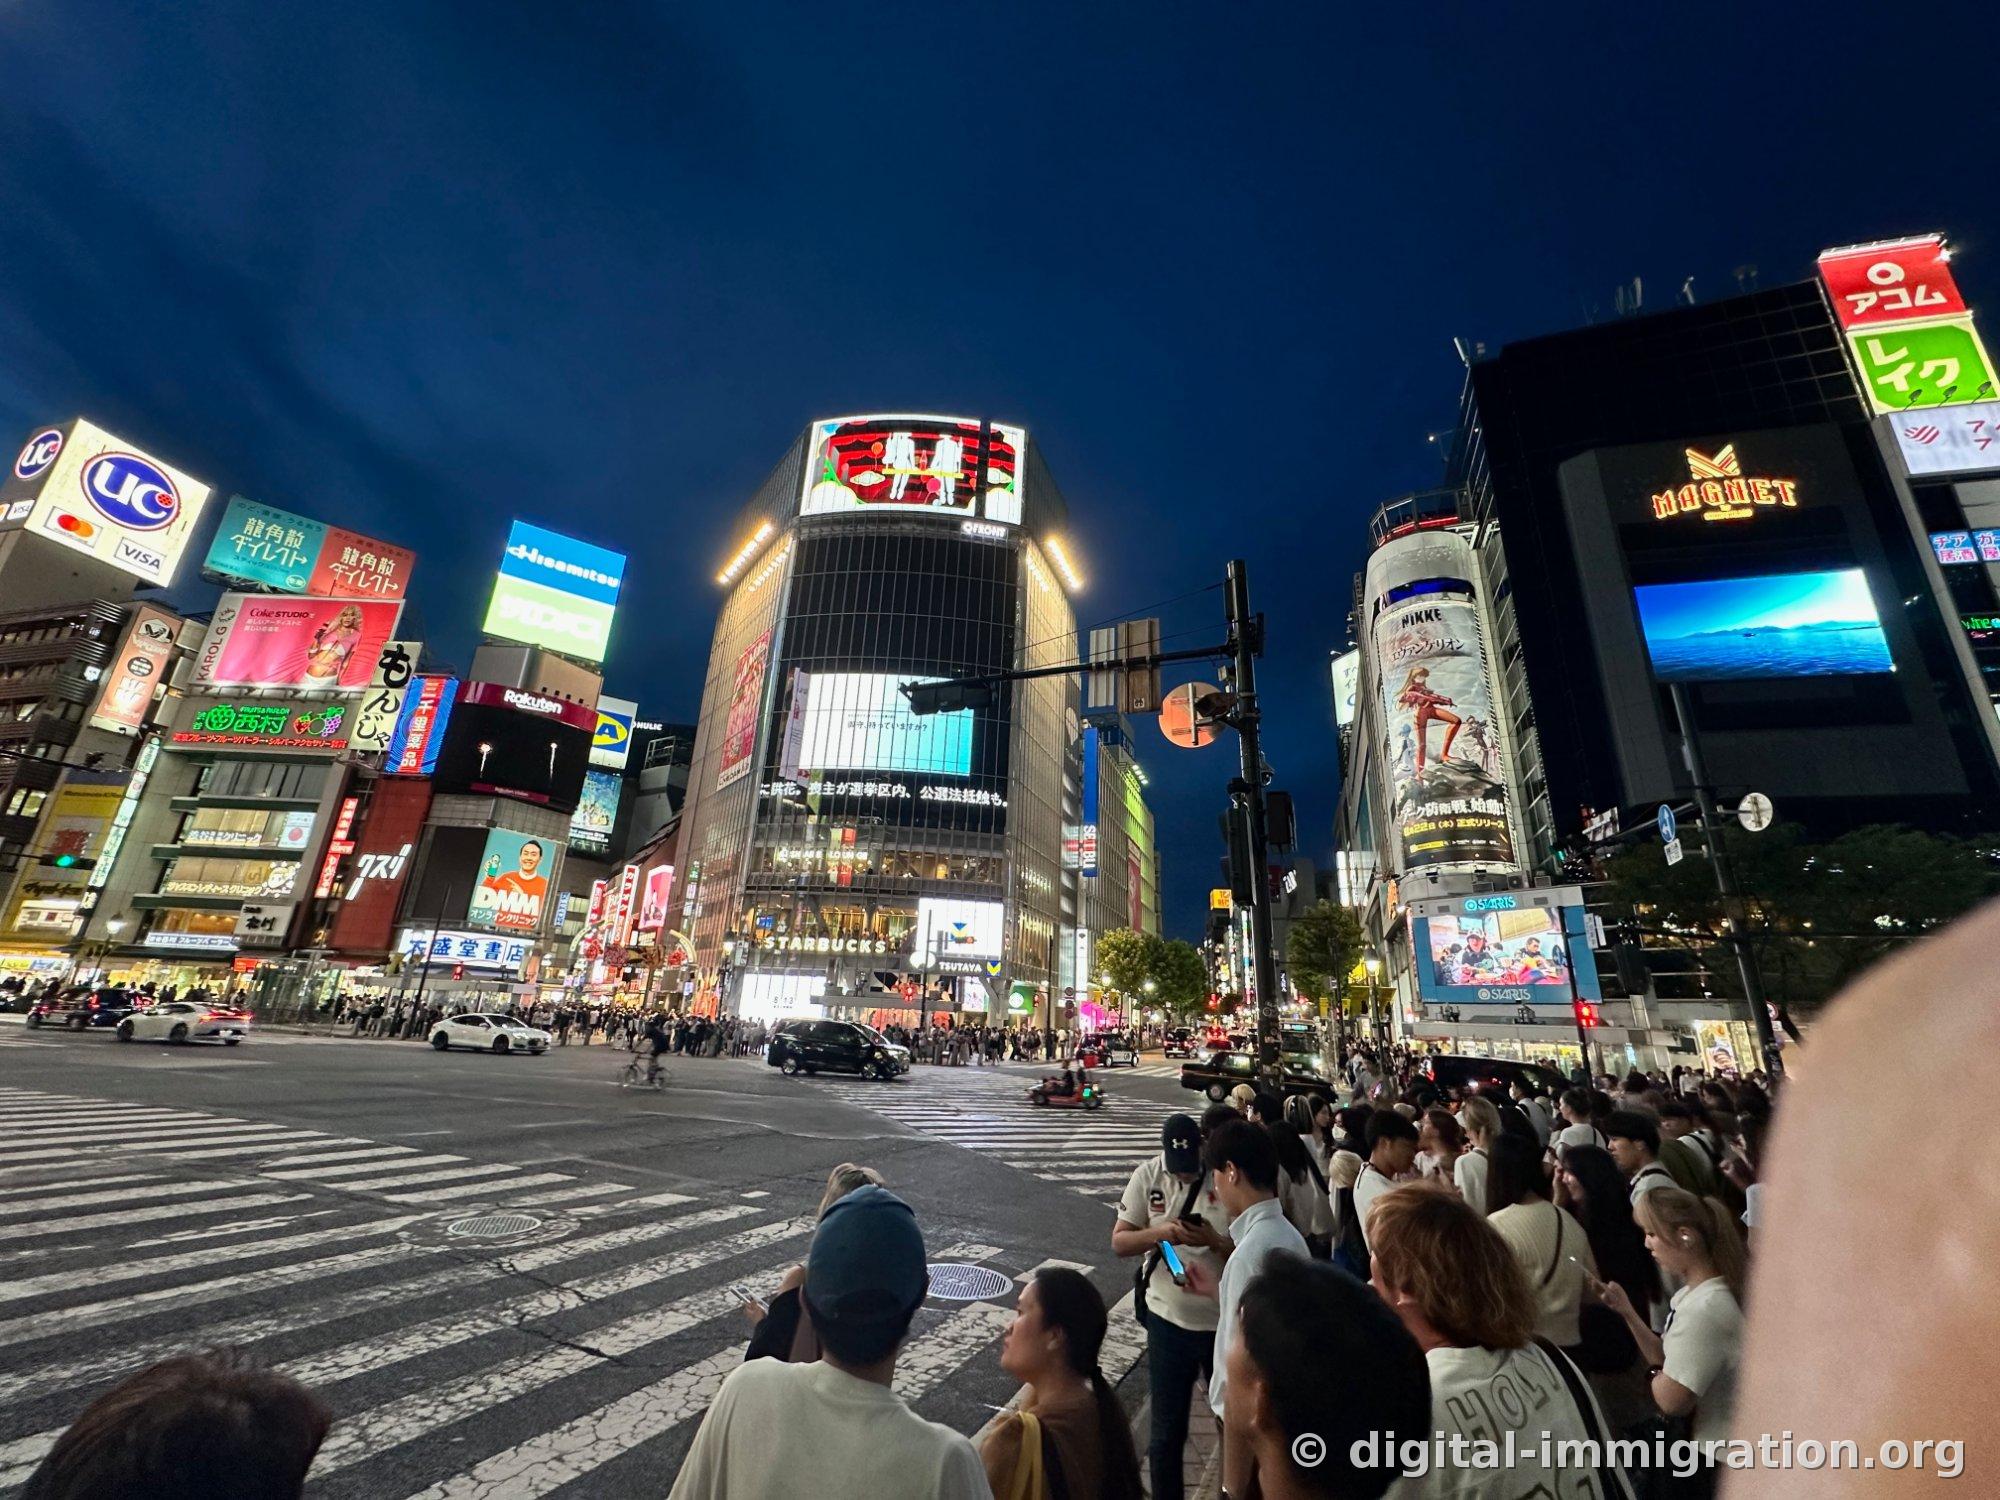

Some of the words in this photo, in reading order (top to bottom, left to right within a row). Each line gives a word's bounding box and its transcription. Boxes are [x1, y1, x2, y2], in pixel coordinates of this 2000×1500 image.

[1846, 285, 1947, 316] アコム
[1866, 339, 1960, 392] レイク
[93, 459, 173, 519] UC
[1651, 478, 1798, 520] MAGNET
[243, 517, 305, 550] 龍角散
[123, 543, 160, 570] VISA
[340, 547, 396, 576] 龍角散
[250, 608, 275, 619] Coke
[274, 610, 309, 619] STUDIO
[1401, 608, 1442, 629] NIKKE
[197, 638, 223, 681] KAROL
[215, 626, 228, 637] G
[357, 643, 412, 748] もんじゃ
[504, 689, 563, 715] Rakuten
[233, 713, 287, 733] 西村
[472, 885, 540, 917] DMM
[1477, 896, 1516, 910] STARTS
[470, 909, 538, 926] オンラインクリニック
[764, 935, 887, 953] STARBUCKS
[939, 961, 982, 972] TSUTAYA
[1490, 988, 1531, 1000] STARTS
